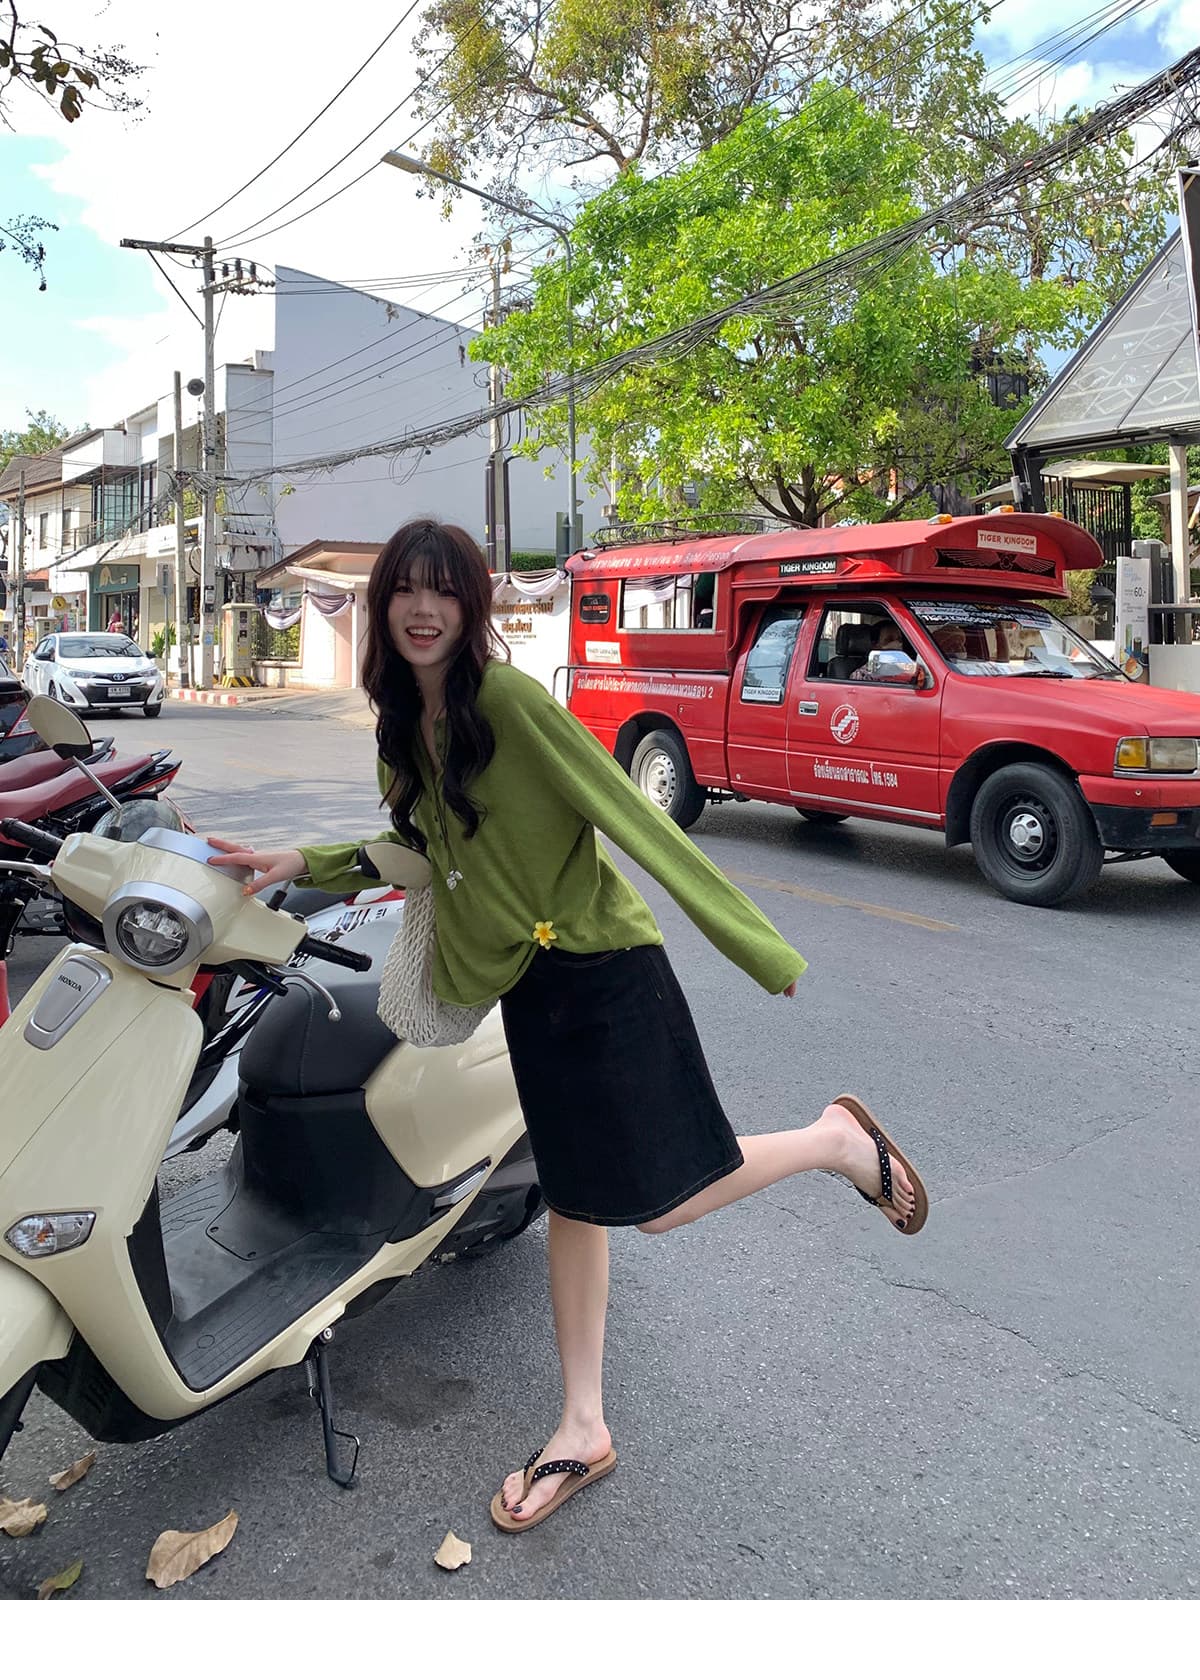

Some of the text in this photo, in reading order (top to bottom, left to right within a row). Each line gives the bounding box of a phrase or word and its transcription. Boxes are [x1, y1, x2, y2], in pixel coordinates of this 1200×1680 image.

[979, 533, 1035, 546] TIGER KINGDOM
[780, 561, 836, 574] TIGER KINGDOM
[707, 686, 714, 698] 2
[58, 975, 82, 991] HONDA
